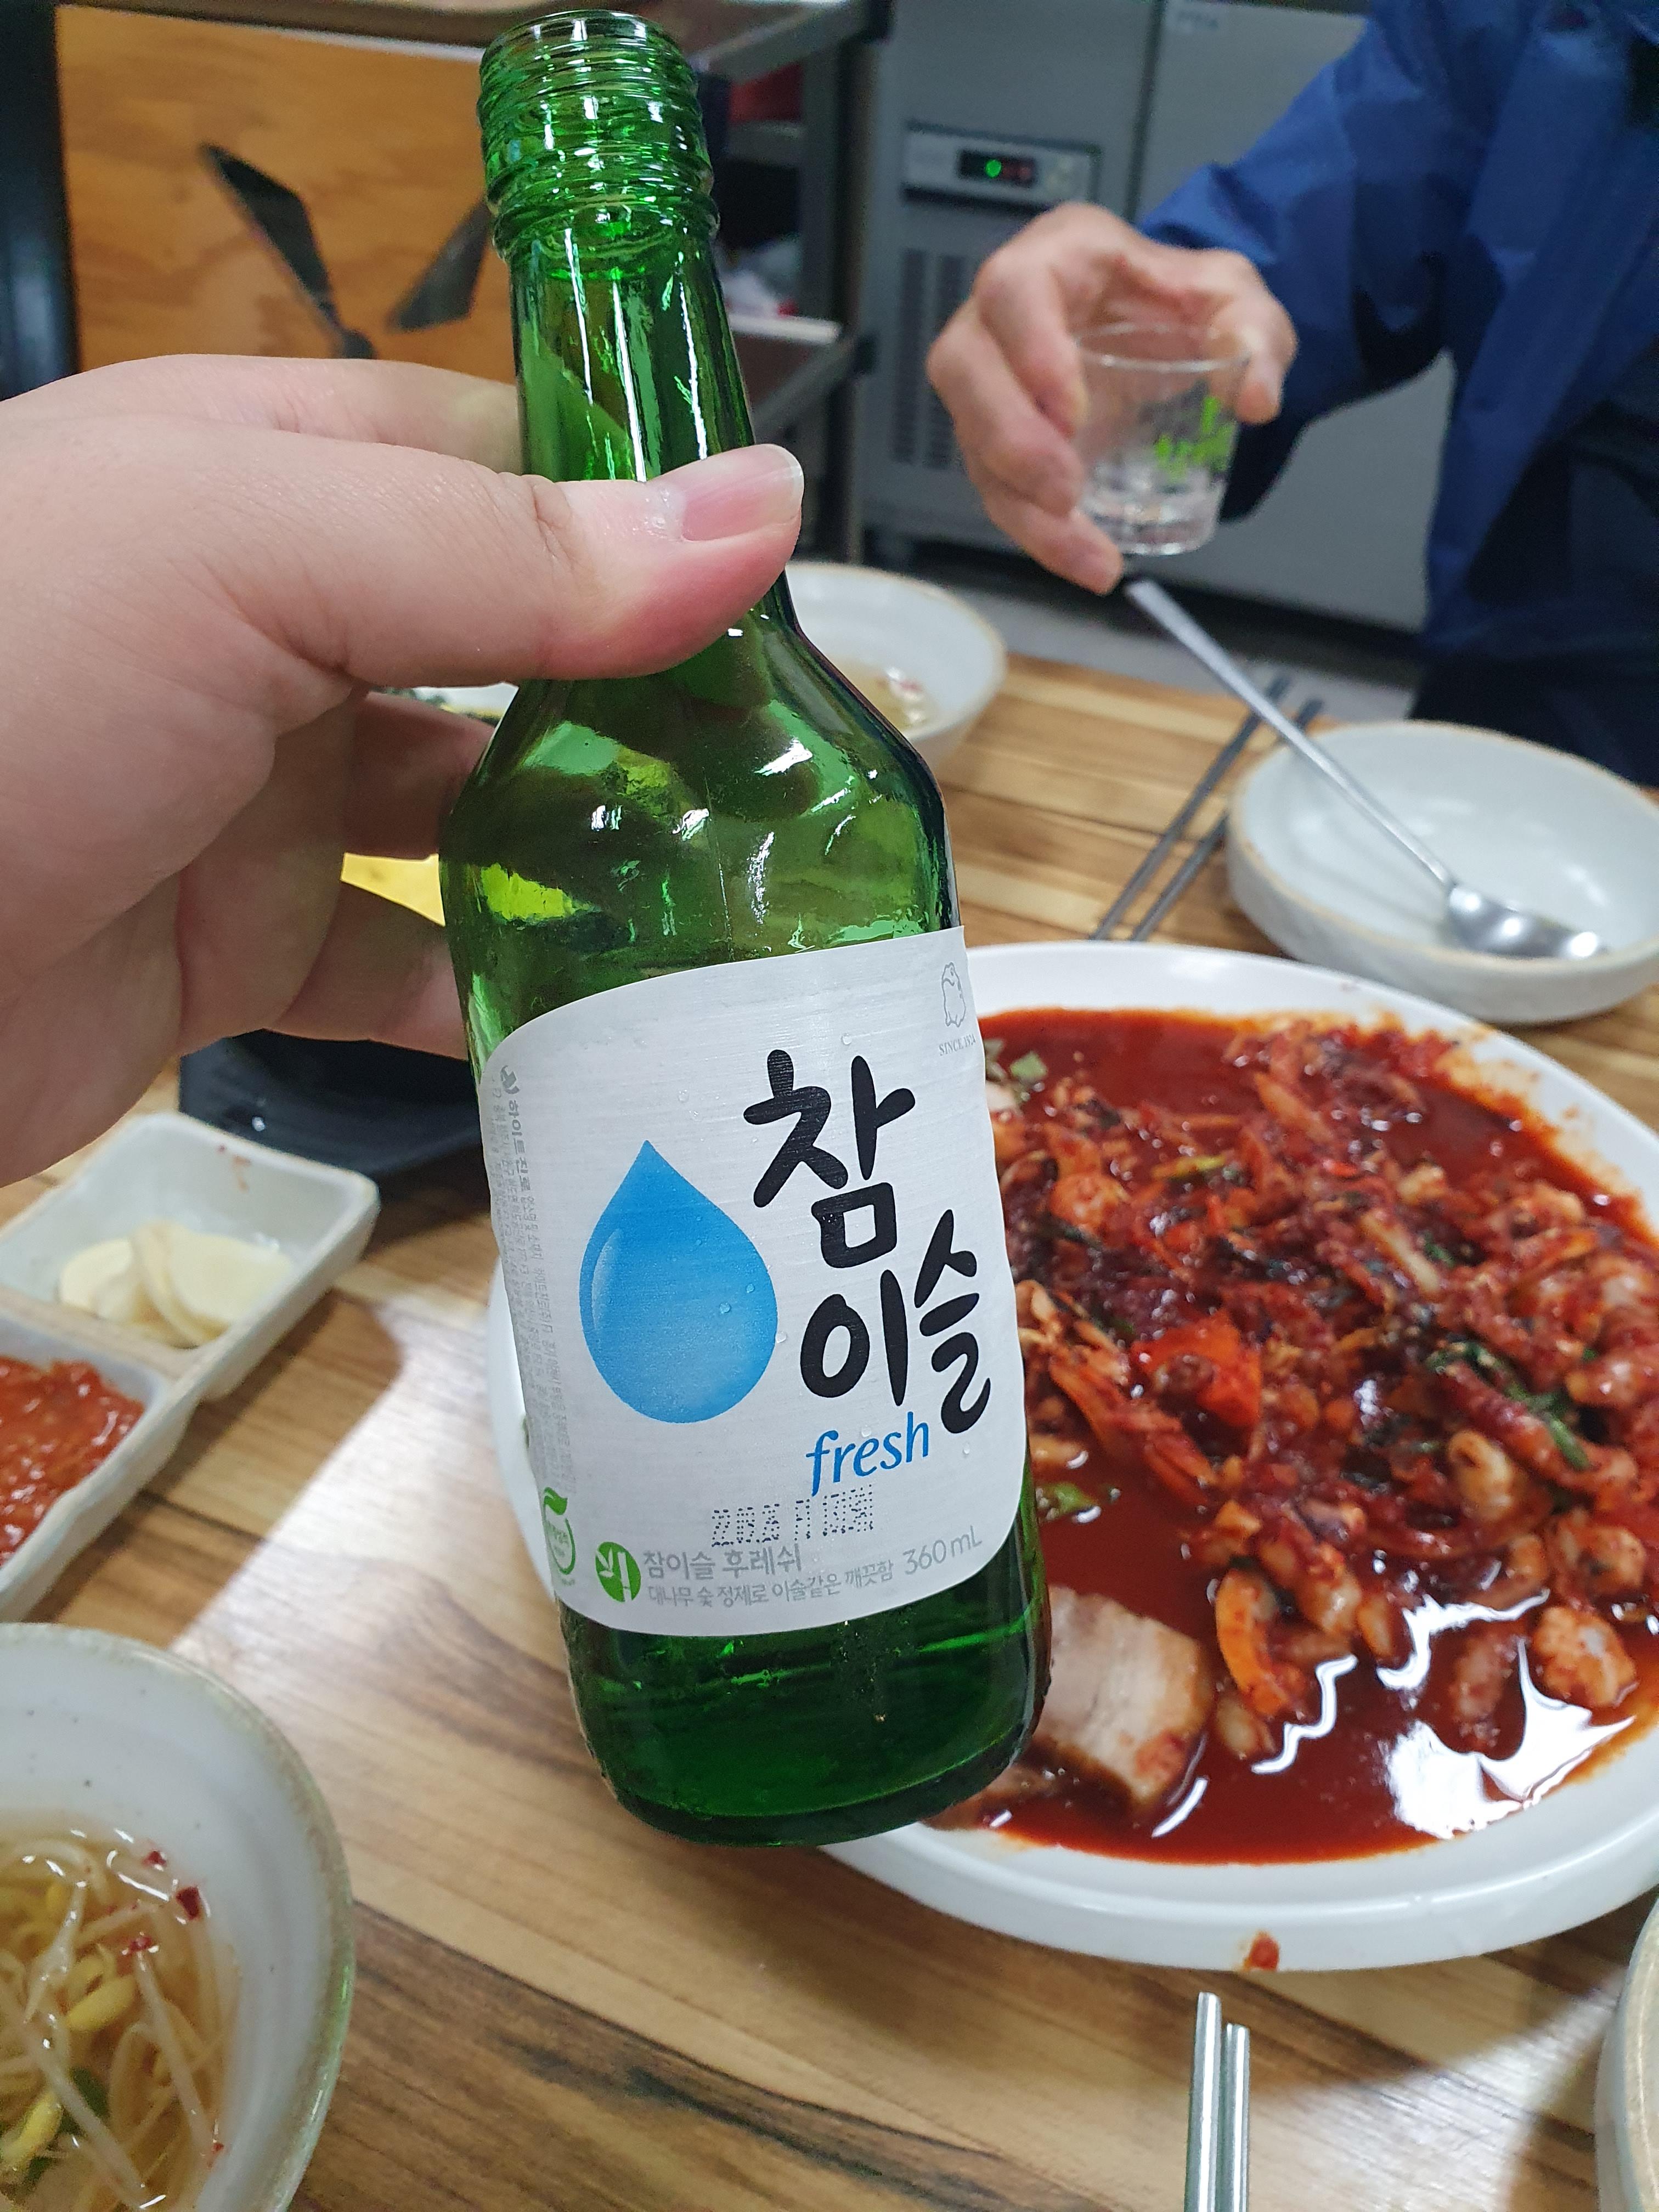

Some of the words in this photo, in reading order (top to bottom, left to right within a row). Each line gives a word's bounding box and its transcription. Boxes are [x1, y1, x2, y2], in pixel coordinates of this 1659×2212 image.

[939, 1036, 964, 1056] SINCE
[506, 1099, 531, 1192] 하이트진로
[806, 1412, 928, 1497] fresh
[644, 1550, 715, 1580] 참이슬
[723, 1543, 802, 1578] 후레쉬
[648, 1585, 693, 1606] 대나무
[697, 1586, 714, 1607] 숯
[716, 1583, 770, 1608] 정제로
[772, 1572, 842, 1602] 이슬같은
[844, 1559, 894, 1589] 깨끗함
